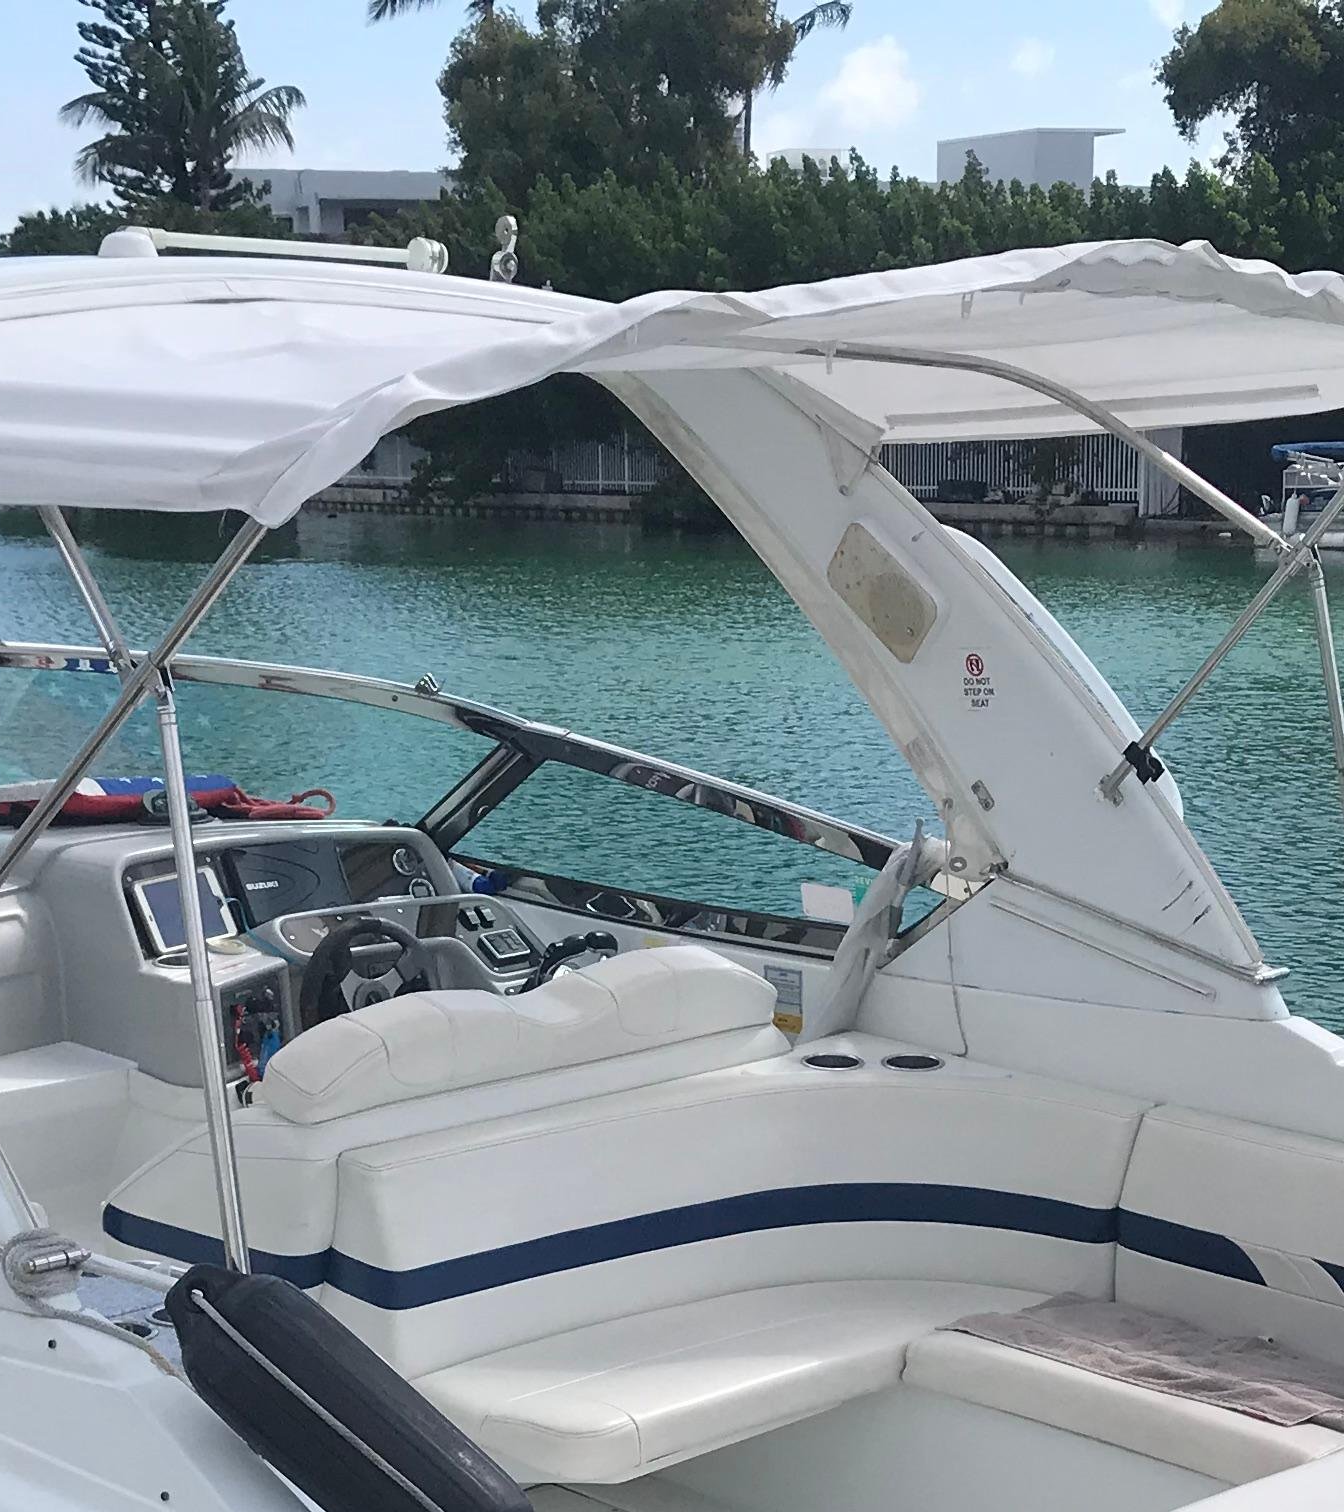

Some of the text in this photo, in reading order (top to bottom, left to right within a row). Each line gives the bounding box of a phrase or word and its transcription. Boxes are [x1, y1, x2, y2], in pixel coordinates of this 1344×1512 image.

[963, 677, 990, 686] DO NOT
[963, 688, 995, 696] STEP ON
[245, 881, 279, 890] SUZUKI
